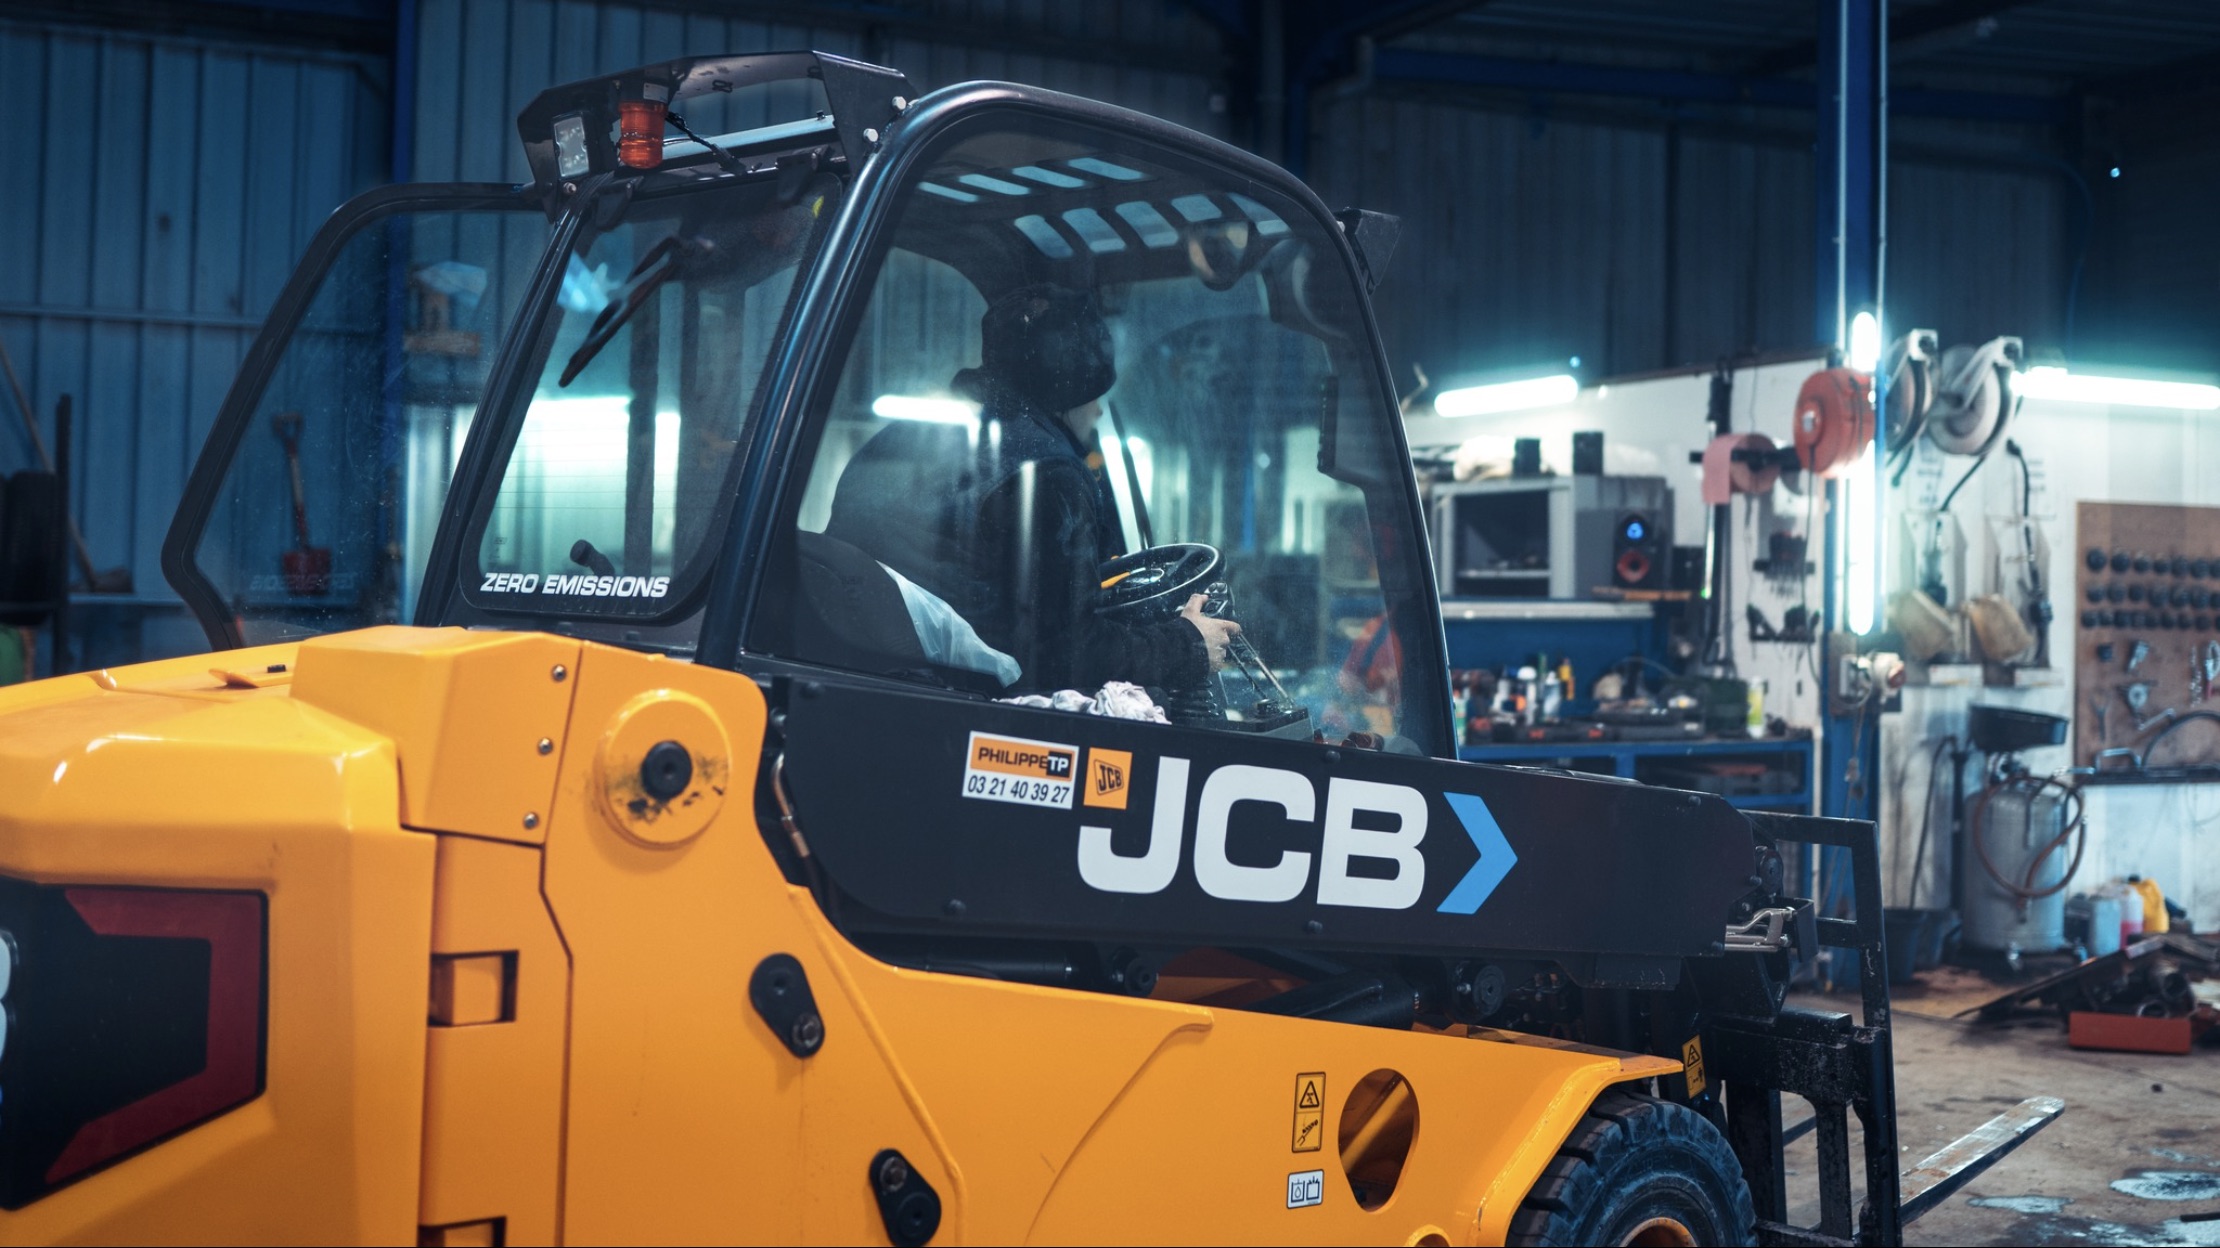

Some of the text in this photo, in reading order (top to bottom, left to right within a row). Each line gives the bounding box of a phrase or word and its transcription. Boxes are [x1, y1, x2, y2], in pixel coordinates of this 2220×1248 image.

[480, 572, 670, 598] ZERO EMISSIONS
[968, 775, 1070, 804] 03 21 40 39 27
[1098, 764, 1122, 792] JCB
[1078, 756, 1429, 911] JCB
